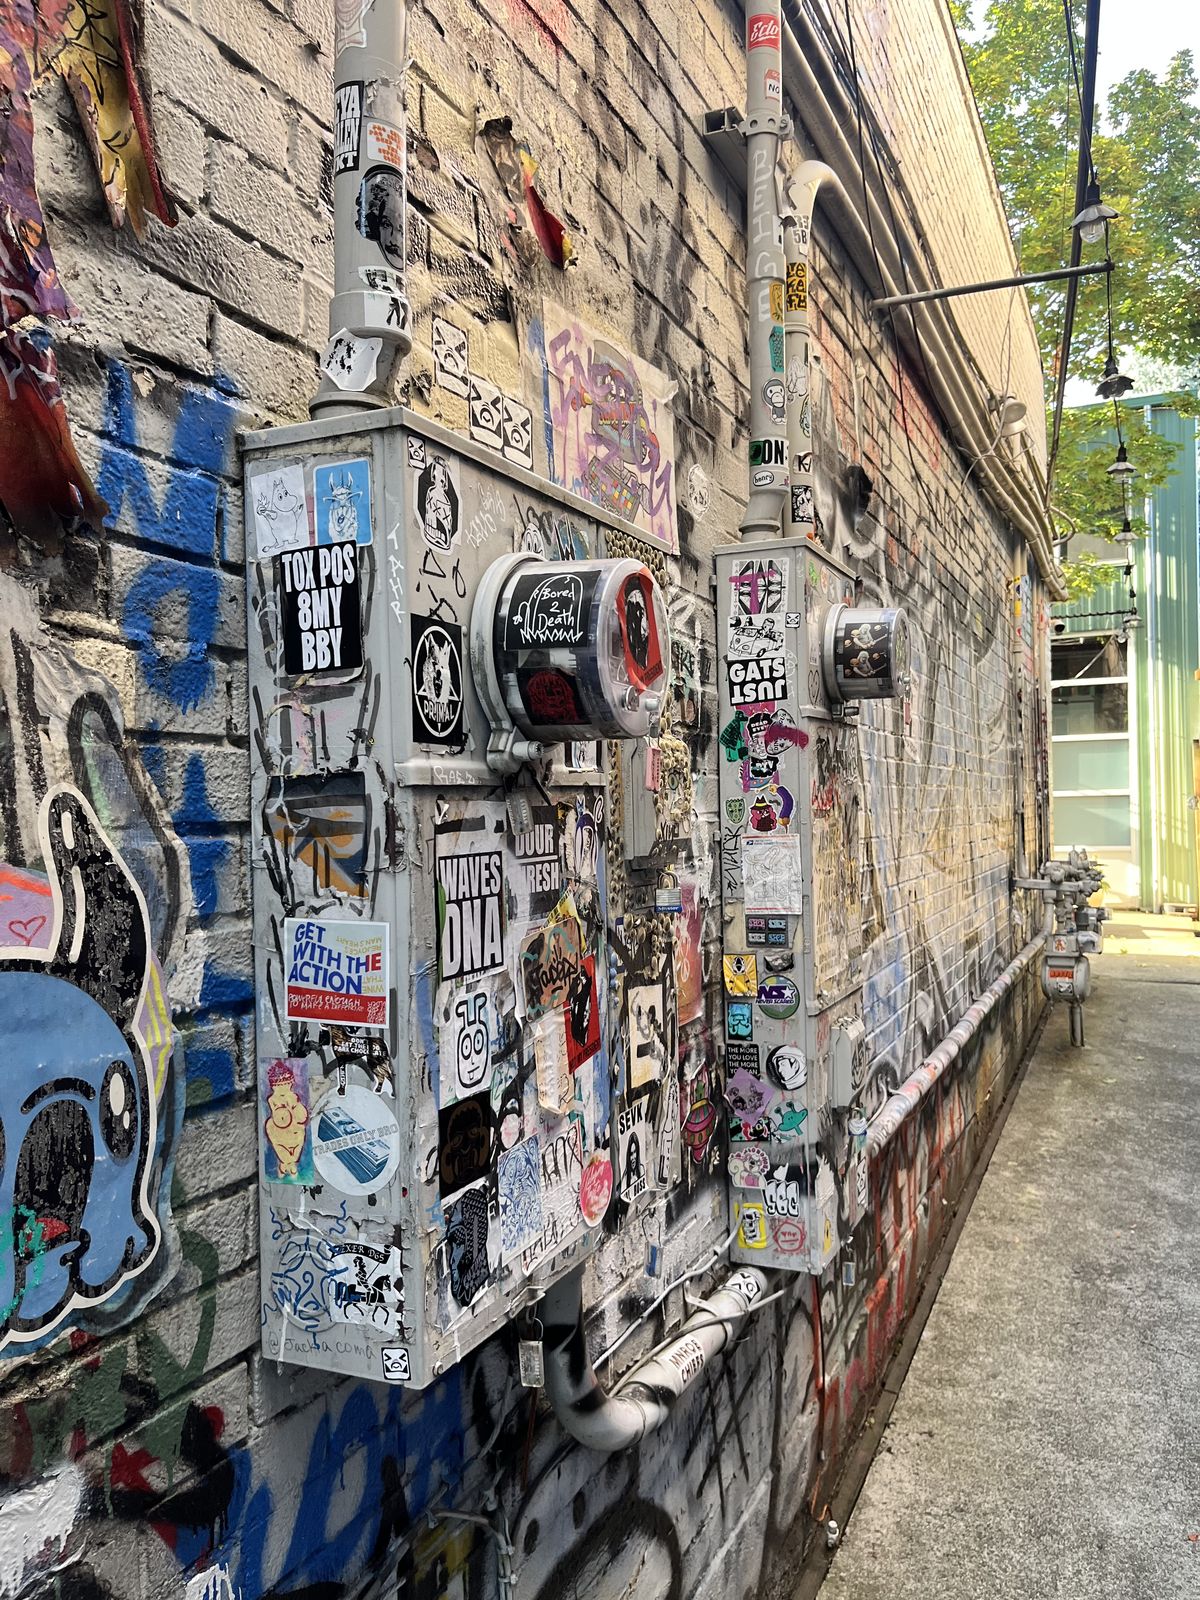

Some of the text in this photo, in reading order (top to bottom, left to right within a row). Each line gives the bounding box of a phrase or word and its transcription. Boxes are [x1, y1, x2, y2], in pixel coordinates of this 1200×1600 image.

[750, 20, 779, 42] Ecto
[281, 544, 355, 593] TOX POS
[541, 583, 575, 601] Bored
[549, 601, 560, 614] 2
[297, 586, 343, 631] 8MY
[537, 604, 575, 632] Death
[301, 628, 343, 671] BBY
[729, 660, 785, 684] GATS
[731, 680, 786, 705] JUST
[750, 720, 768, 728] DEAD
[439, 854, 501, 901] WAVES
[520, 862, 560, 893] RESH
[294, 922, 326, 943] GET
[442, 897, 502, 978] DNA
[293, 941, 382, 973] WITH THE
[288, 961, 363, 994] ACTION
[619, 1102, 643, 1135] SEVK
[313, 1123, 399, 1156] TRADES ONLY BRO
[682, 1353, 704, 1383] CHIEFS
